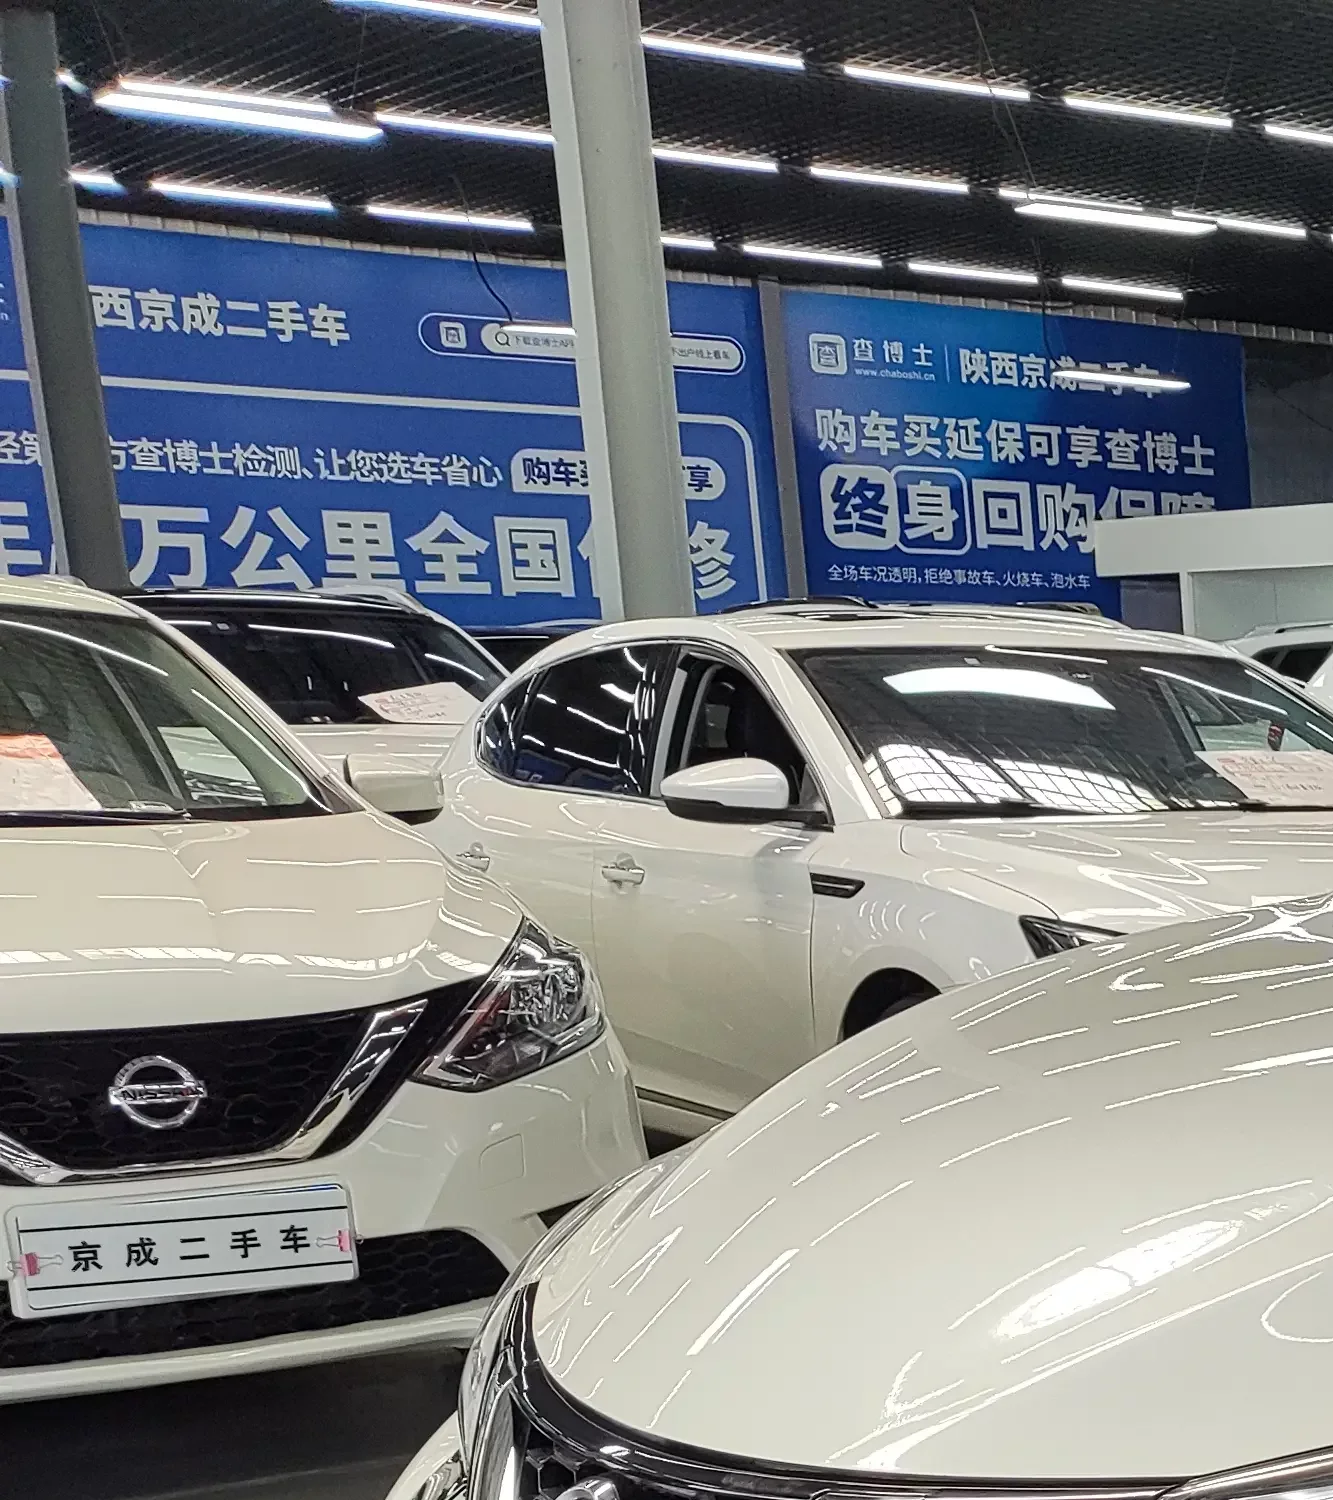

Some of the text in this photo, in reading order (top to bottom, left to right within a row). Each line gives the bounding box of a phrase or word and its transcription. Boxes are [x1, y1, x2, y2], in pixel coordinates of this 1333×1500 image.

[852, 338, 934, 367] 查博士
[853, 367, 936, 382] www.chaboshi.cn
[814, 407, 1216, 477] 购车买延保可享查博士
[67, 1224, 312, 1273] 京成二手车
